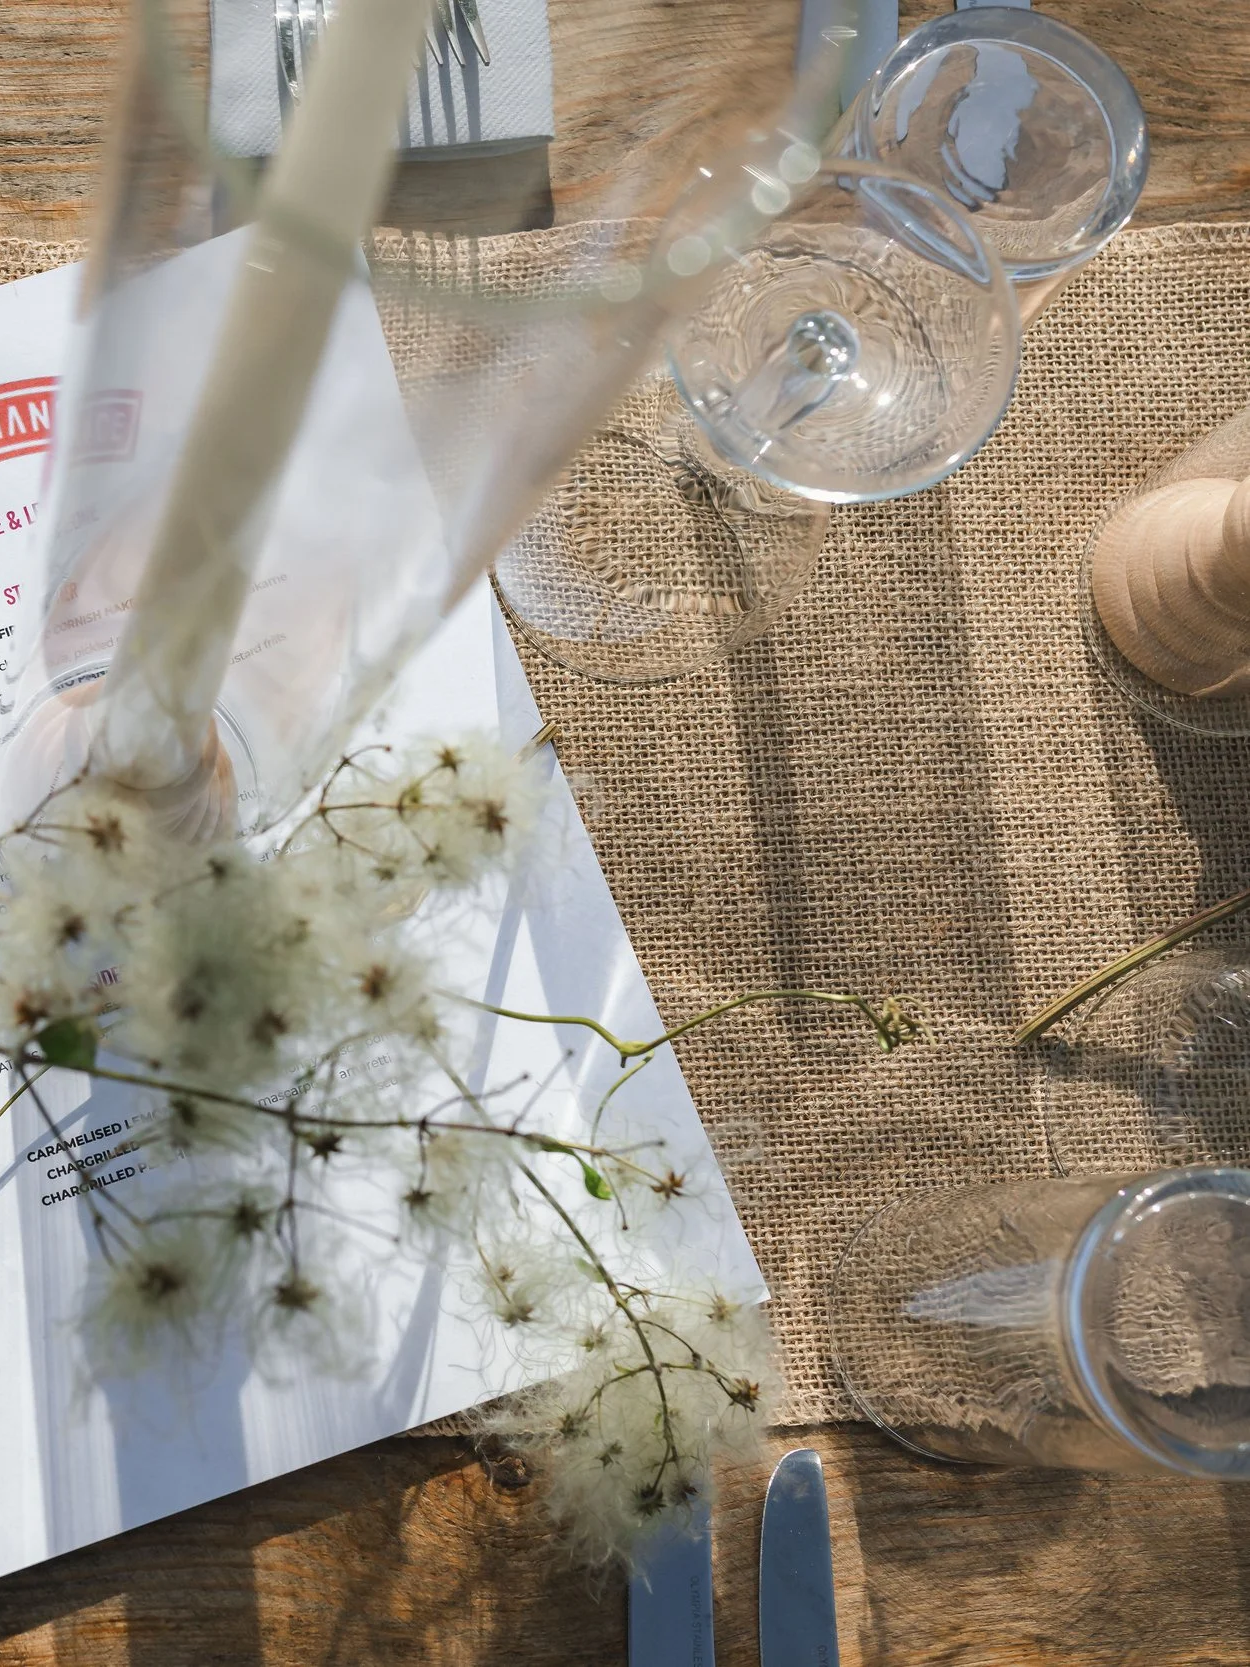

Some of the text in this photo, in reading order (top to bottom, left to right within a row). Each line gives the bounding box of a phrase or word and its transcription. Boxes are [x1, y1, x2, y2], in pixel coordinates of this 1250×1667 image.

[8, 510, 23, 531] &
[26, 1121, 123, 1163] CARAMELISED
[46, 1140, 141, 1181] CHARGRILLED
[41, 1166, 136, 1206] CHARGRILLED
